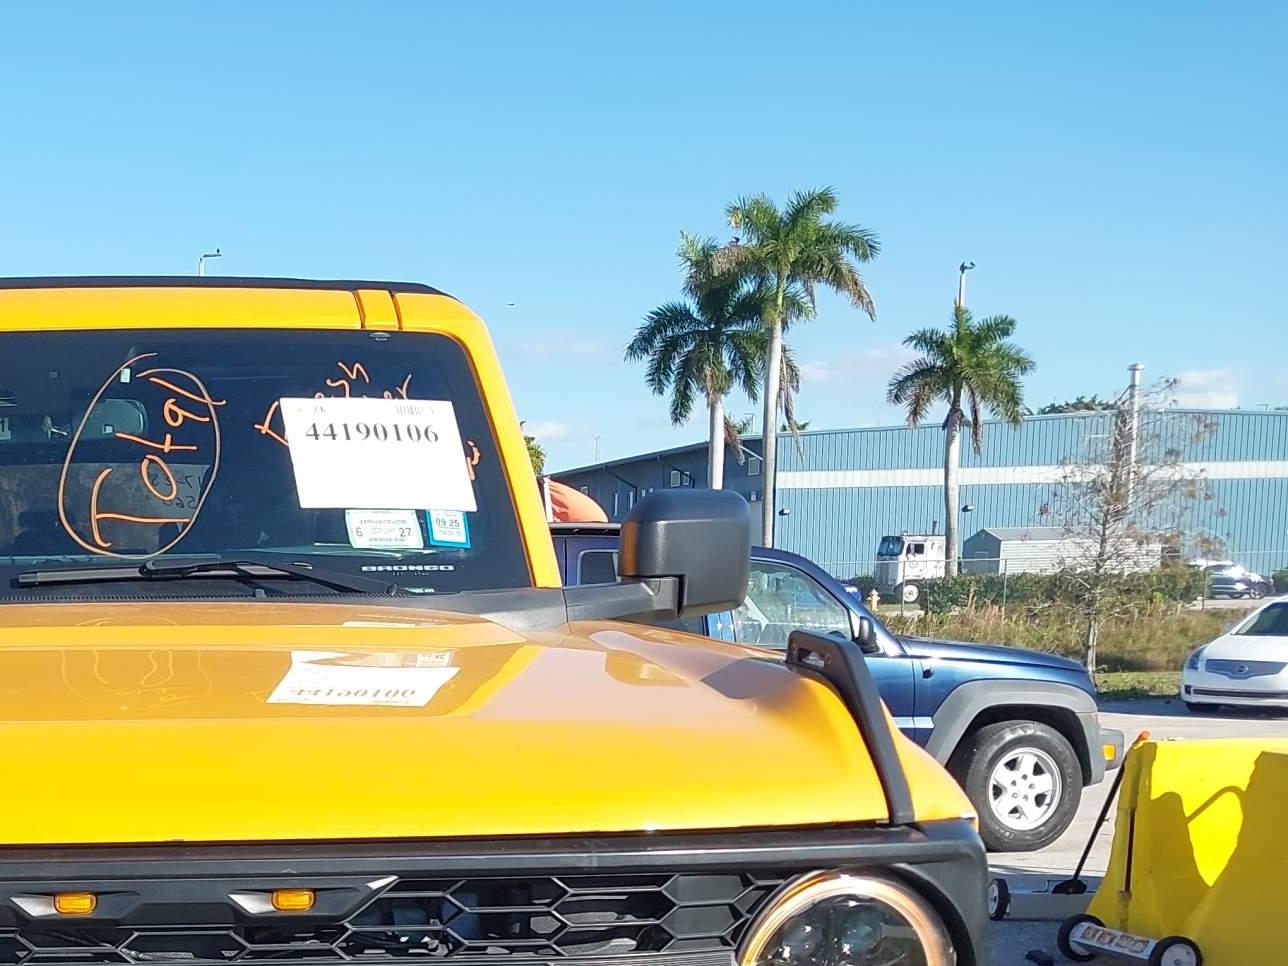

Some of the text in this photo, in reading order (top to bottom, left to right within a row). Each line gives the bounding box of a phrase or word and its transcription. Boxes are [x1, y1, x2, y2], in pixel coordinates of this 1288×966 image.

[305, 421, 440, 444] 44190106
[355, 527, 413, 538] 6 27
